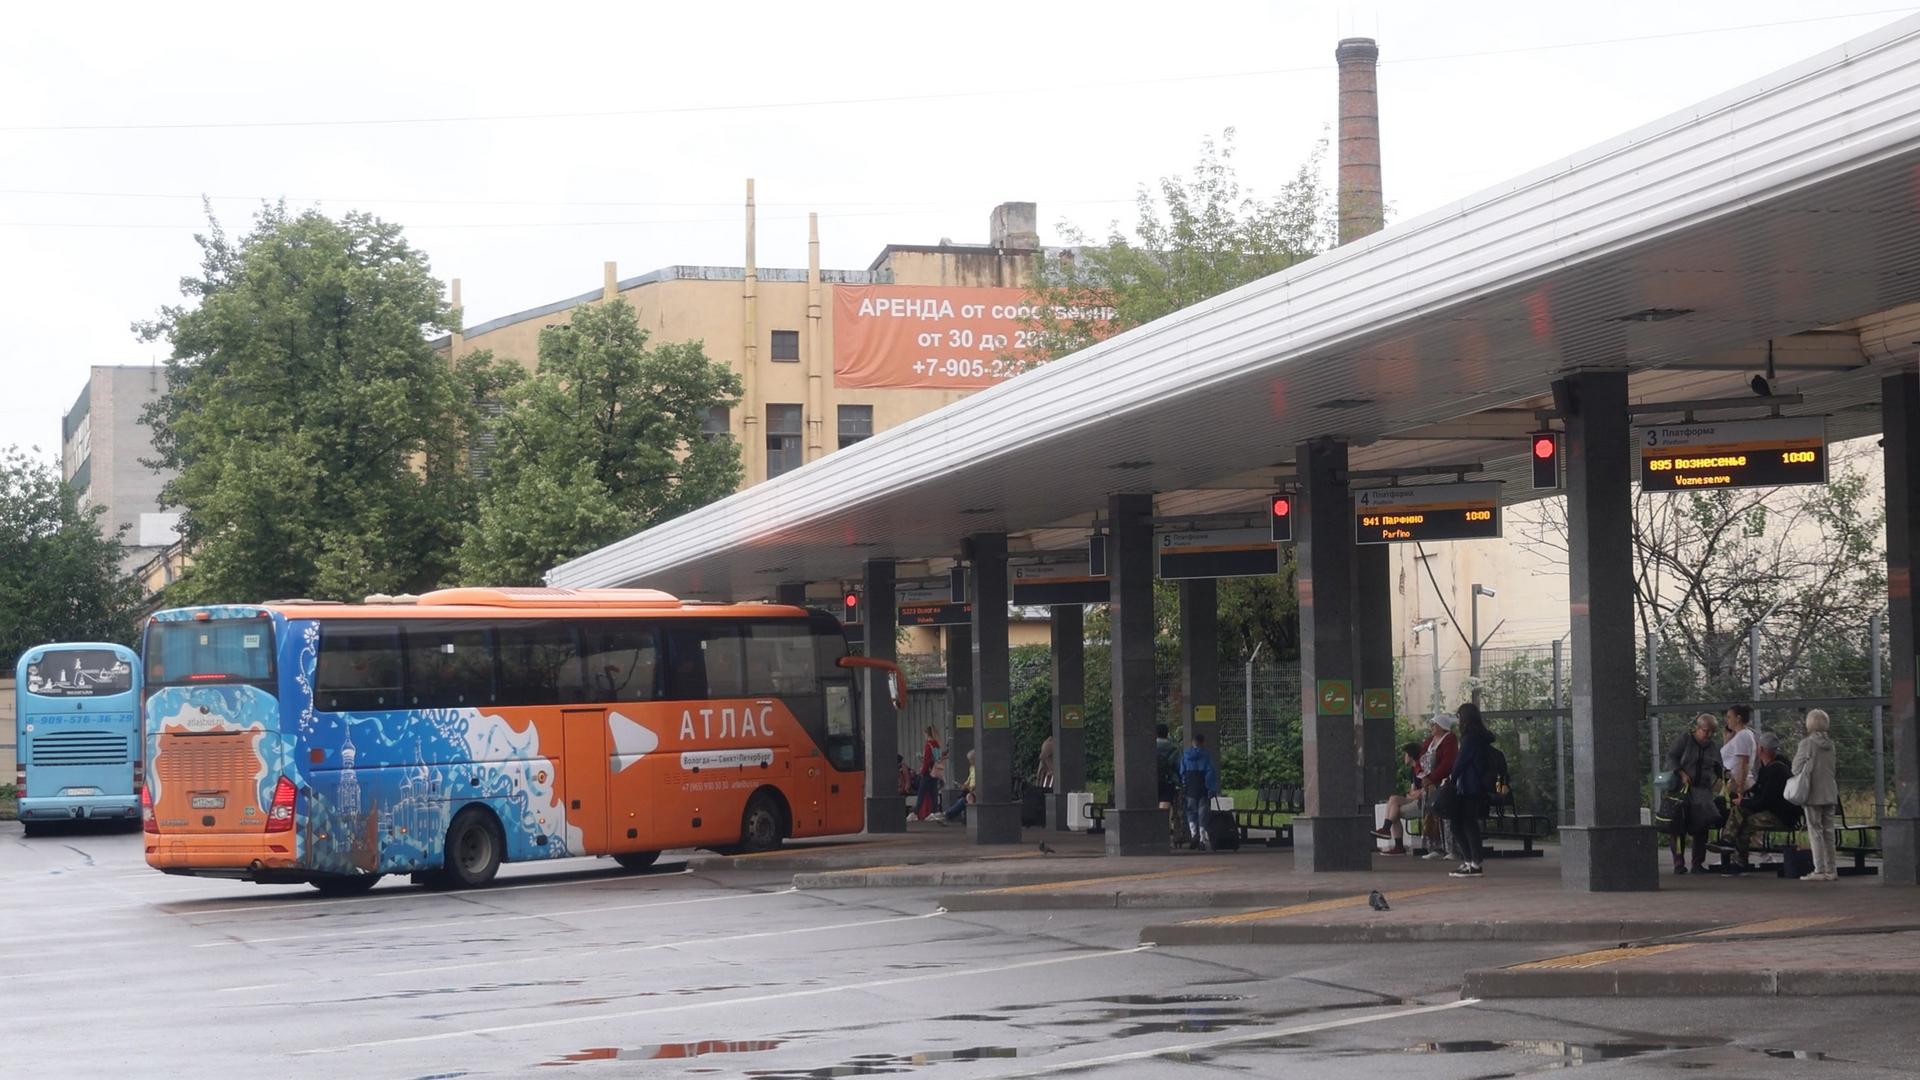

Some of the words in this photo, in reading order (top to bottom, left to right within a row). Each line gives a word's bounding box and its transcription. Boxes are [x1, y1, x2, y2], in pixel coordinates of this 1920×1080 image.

[859, 298, 954, 321] АРЕНДА
[961, 304, 985, 320] от
[918, 332, 942, 348] от
[949, 329, 973, 349] 30
[979, 333, 1008, 352] до
[1647, 430, 1657, 446] 3
[1662, 428, 1715, 440] Платформа
[1650, 459, 1672, 471] 895
[1675, 456, 1746, 469] Вознесенье
[1782, 451, 1815, 463] 10:00
[1361, 492, 1369, 506] 4
[1363, 517, 1379, 526] 941
[1465, 511, 1490, 520] 10:00
[1163, 535, 1171, 547] 5
[680, 706, 774, 740] АТЛАС
[684, 756, 710, 765] Вологда
